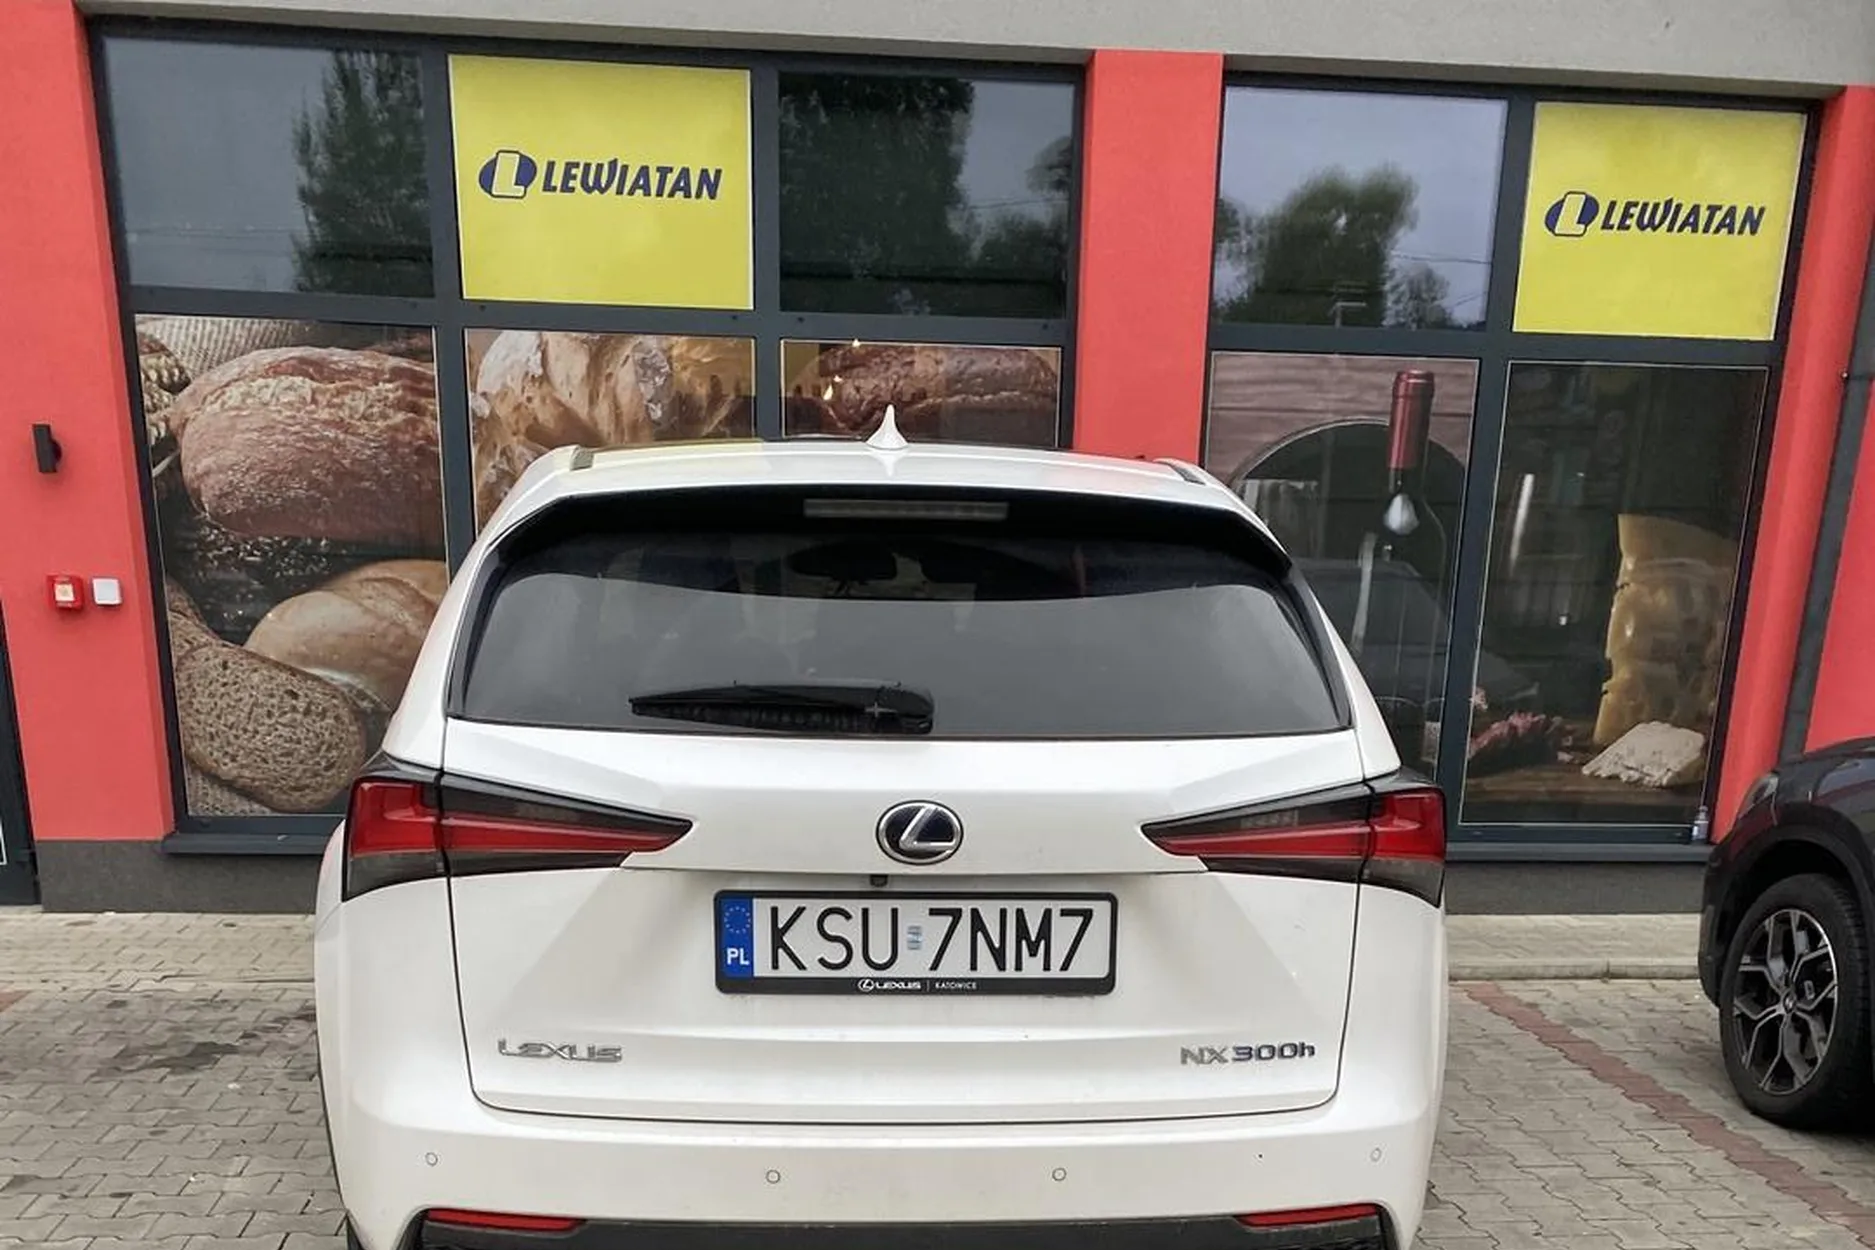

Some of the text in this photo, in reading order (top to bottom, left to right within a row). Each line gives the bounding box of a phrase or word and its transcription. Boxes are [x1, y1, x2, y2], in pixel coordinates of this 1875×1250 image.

[542, 158, 722, 200] LEWIATAN
[1601, 198, 1766, 236] LEWIATAN
[770, 906, 1094, 972] KSU 7NM7
[727, 948, 749, 965] PL
[875, 981, 921, 990] LEXUS
[498, 1039, 622, 1063] LEXUS
